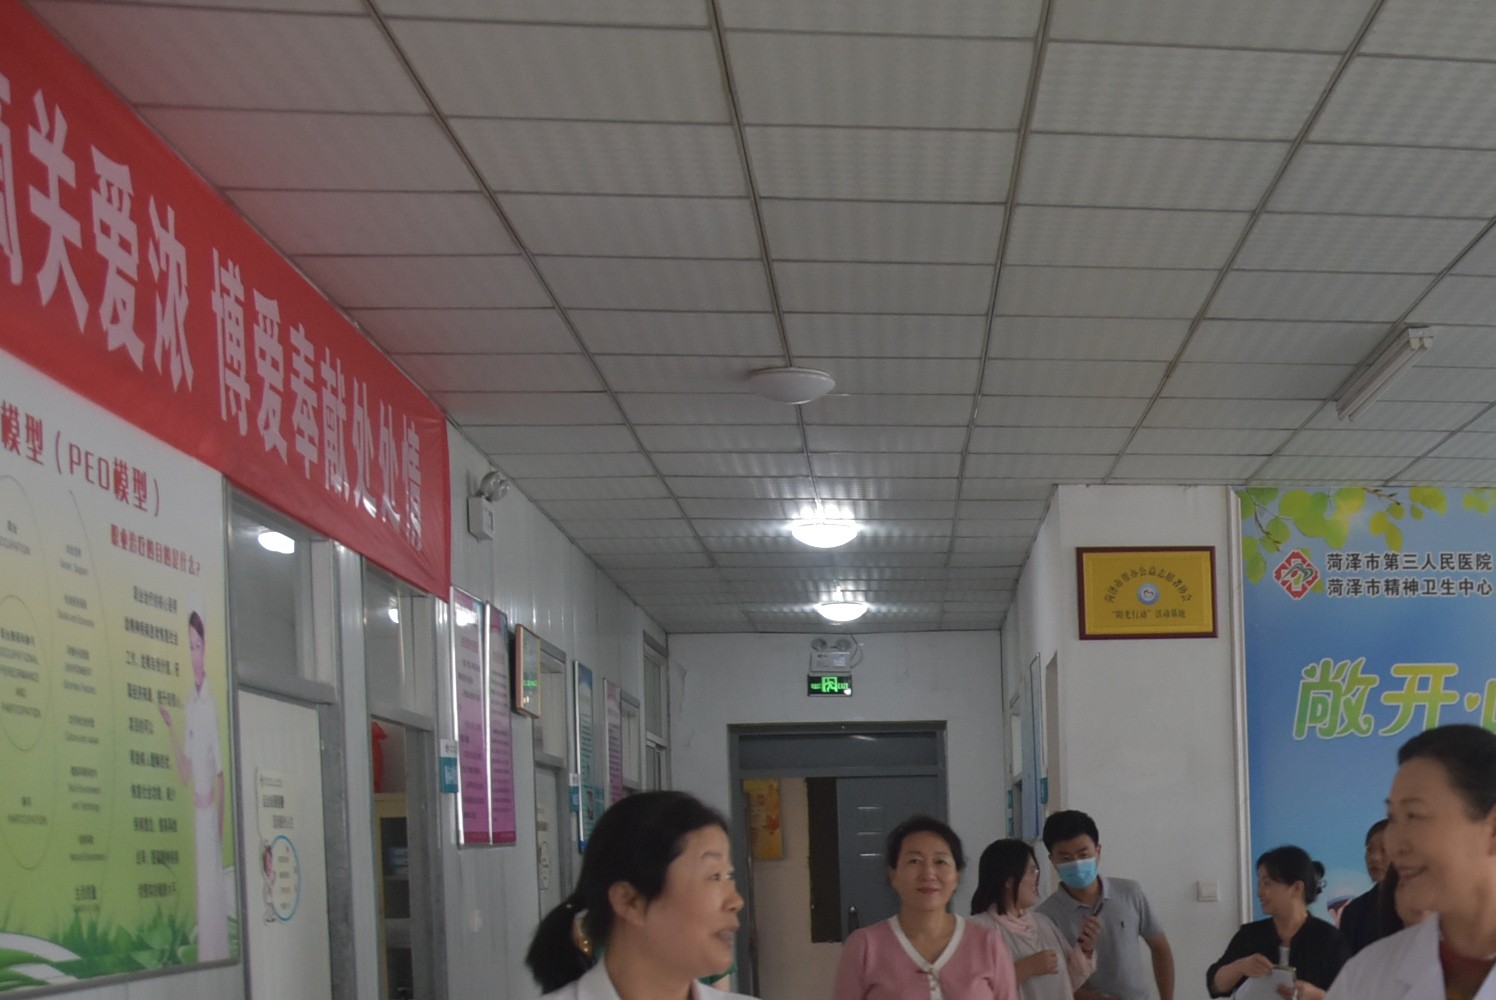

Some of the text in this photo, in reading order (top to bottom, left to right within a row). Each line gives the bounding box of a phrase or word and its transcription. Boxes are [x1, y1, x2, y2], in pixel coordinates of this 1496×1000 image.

[211, 247, 423, 551] 博爱奉献处处情
[1326, 552, 1494, 571] 菏泽市第三人民医院
[1327, 578, 1494, 597] 菏泽市精神卫生中心
